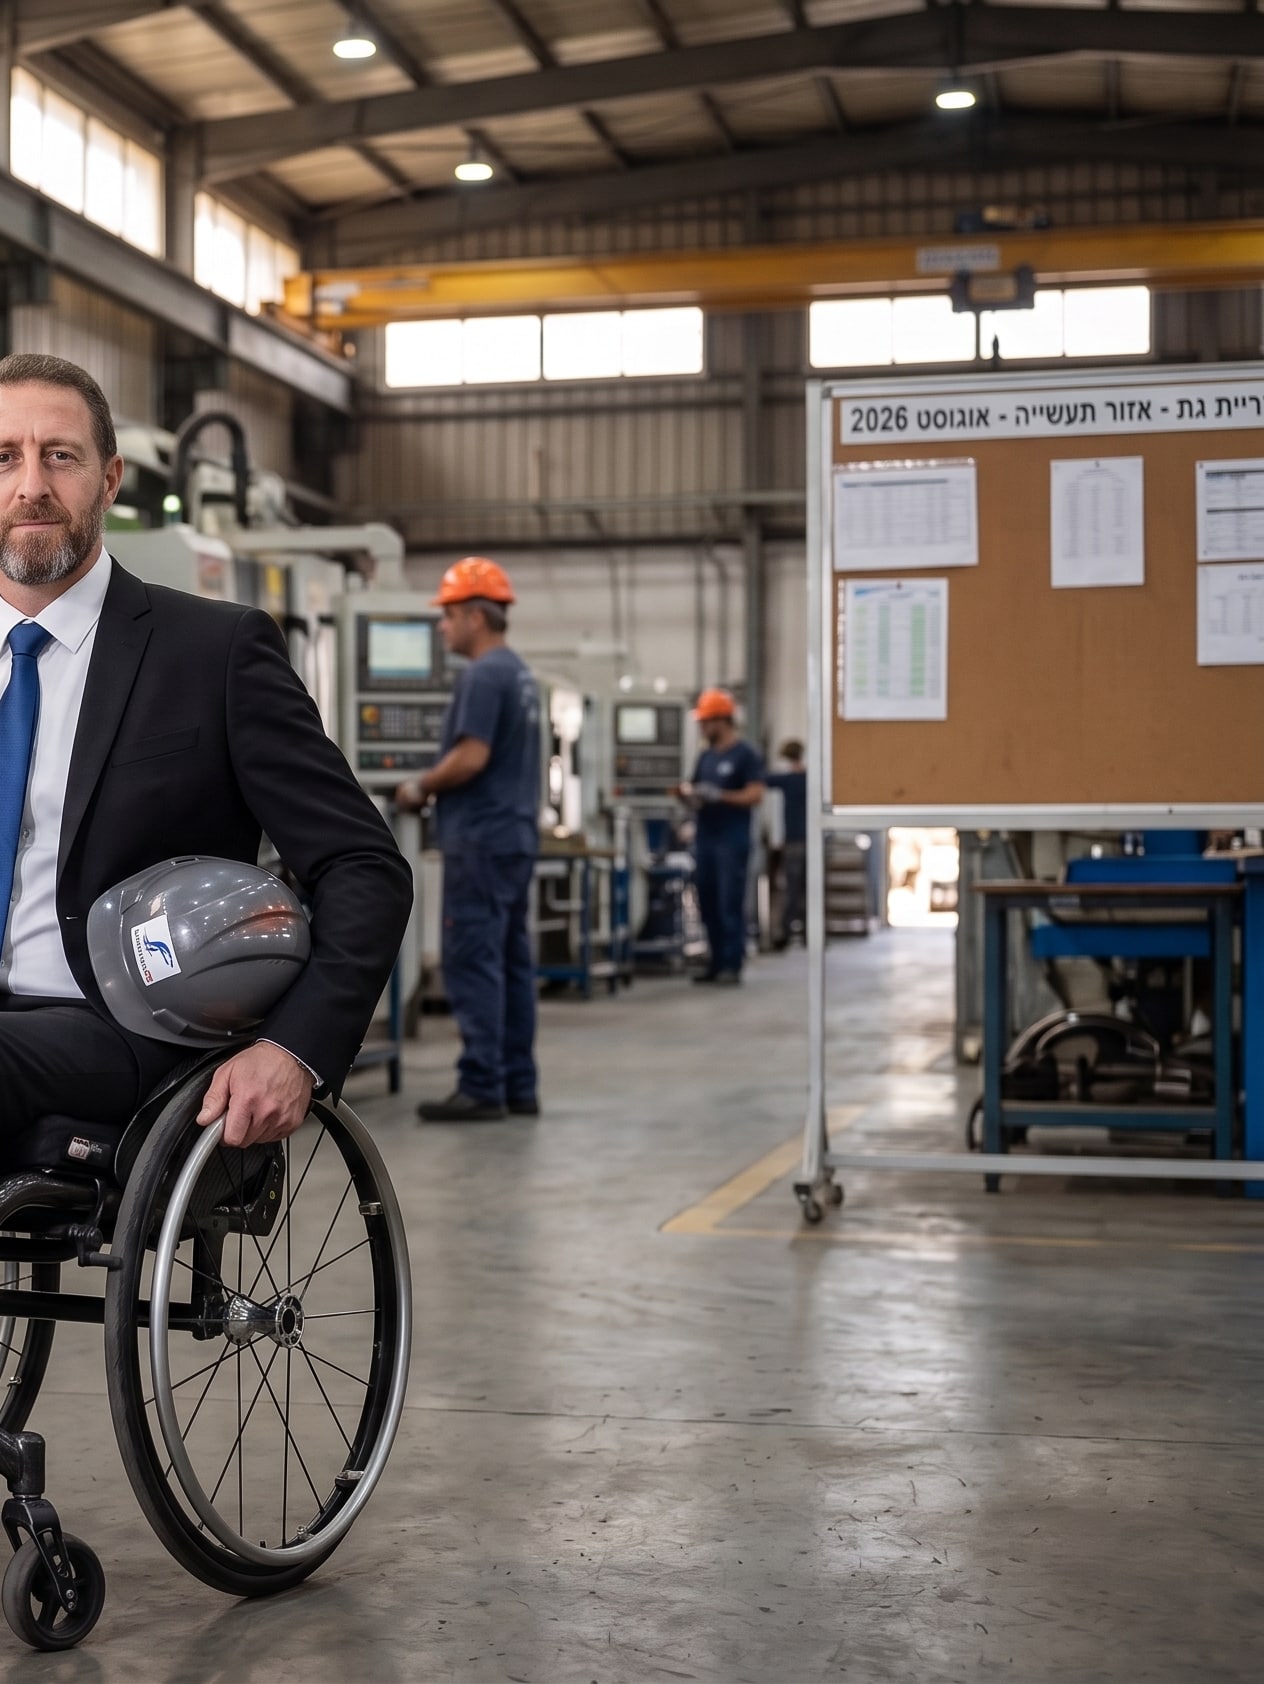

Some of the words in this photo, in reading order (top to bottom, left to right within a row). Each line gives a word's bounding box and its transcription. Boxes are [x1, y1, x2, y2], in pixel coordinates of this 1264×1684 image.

[1015, 401, 1096, 426] תעשייה
[1104, 400, 1152, 421] אזור
[1176, 398, 1206, 419] גת
[1214, 395, 1264, 417] ריית
[850, 405, 909, 433] 2026
[916, 407, 991, 431] אוגוסט
